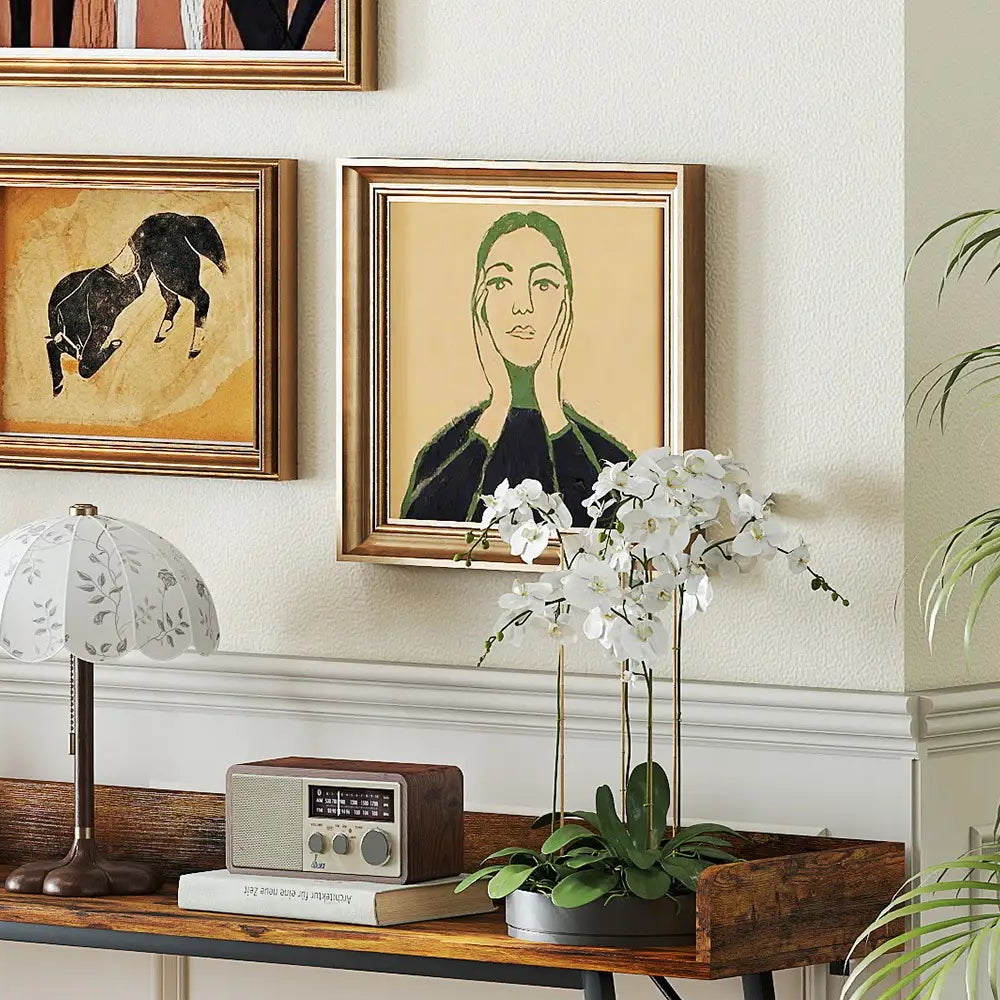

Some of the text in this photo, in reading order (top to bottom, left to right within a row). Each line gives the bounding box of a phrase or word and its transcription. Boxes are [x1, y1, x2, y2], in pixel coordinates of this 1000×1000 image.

[243, 886, 258, 897] Zeit
[260, 887, 278, 897] neue
[280, 888, 296, 900] eine
[311, 891, 352, 905] Architektur
